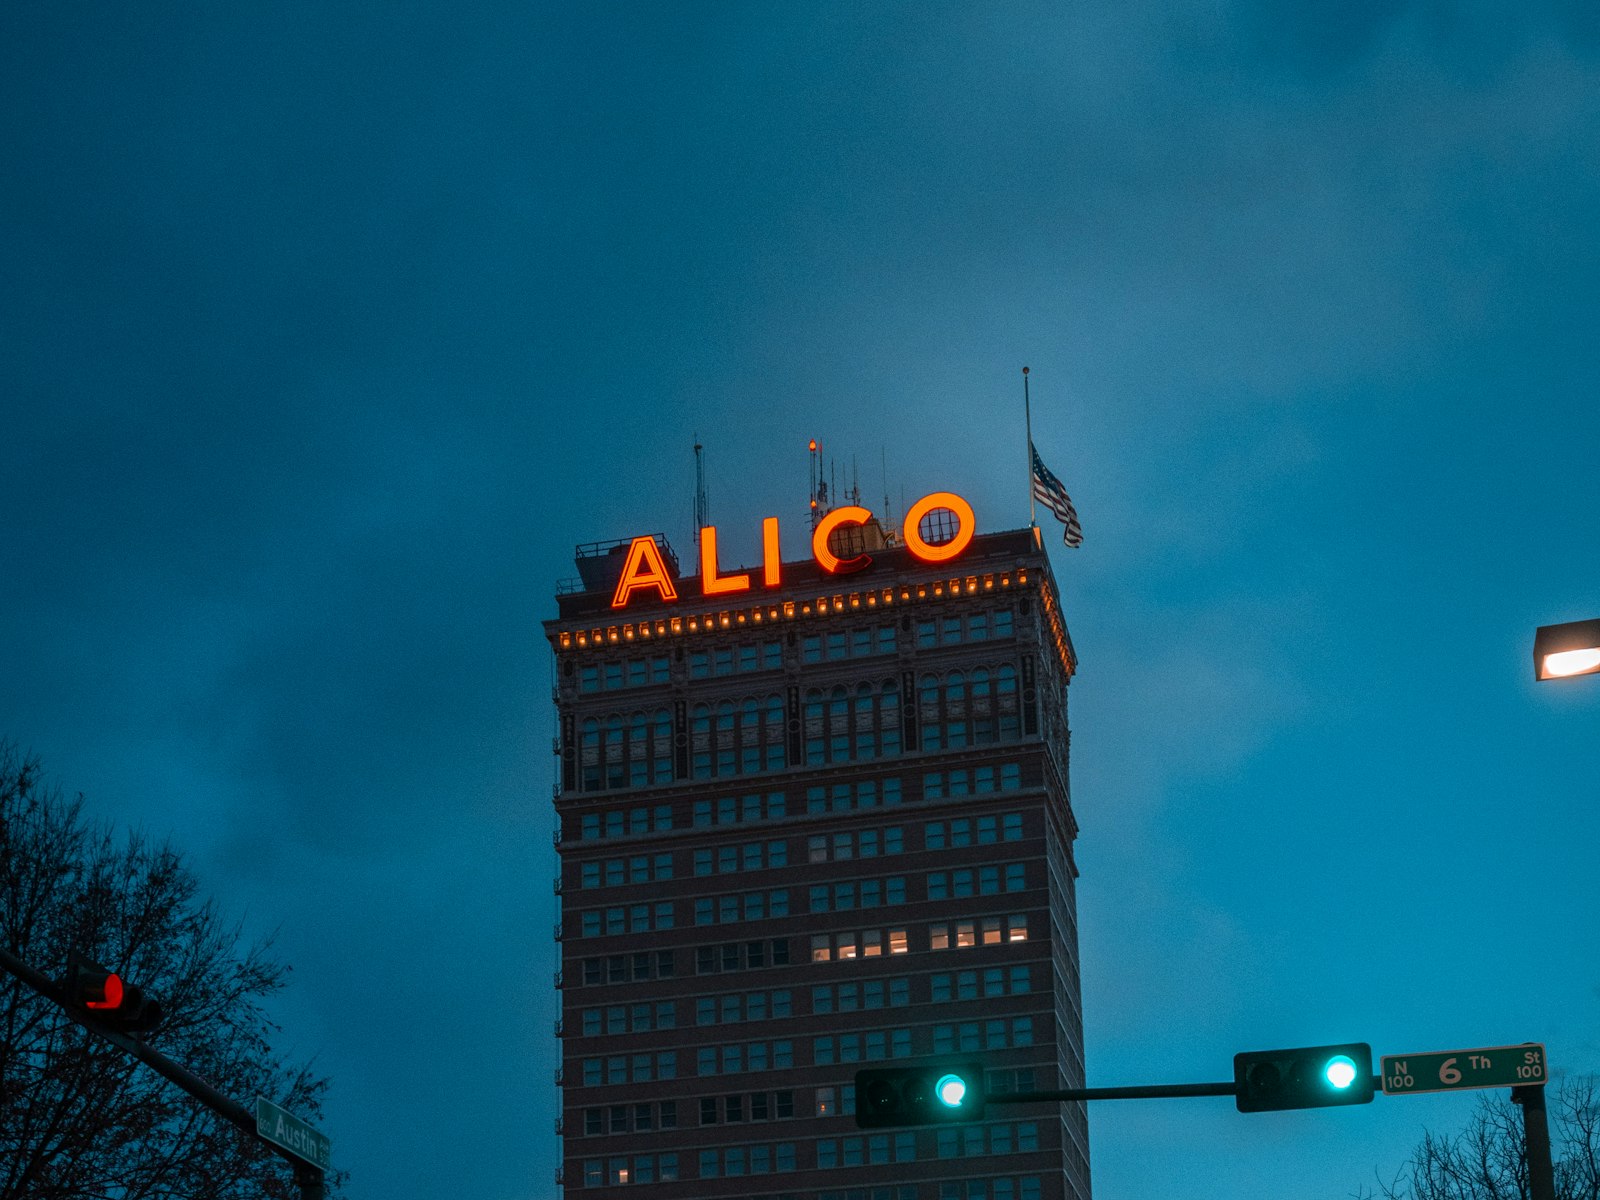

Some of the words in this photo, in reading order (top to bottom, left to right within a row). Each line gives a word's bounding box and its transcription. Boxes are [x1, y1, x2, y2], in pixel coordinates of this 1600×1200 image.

[611, 491, 976, 608] ALICO
[1524, 1051, 1541, 1065] St
[1394, 1061, 1408, 1075] N
[1438, 1058, 1462, 1084] 6
[1468, 1055, 1492, 1070] Th
[1516, 1065, 1542, 1079] 100
[1387, 1075, 1415, 1089] 100
[275, 1113, 317, 1159] Austin
